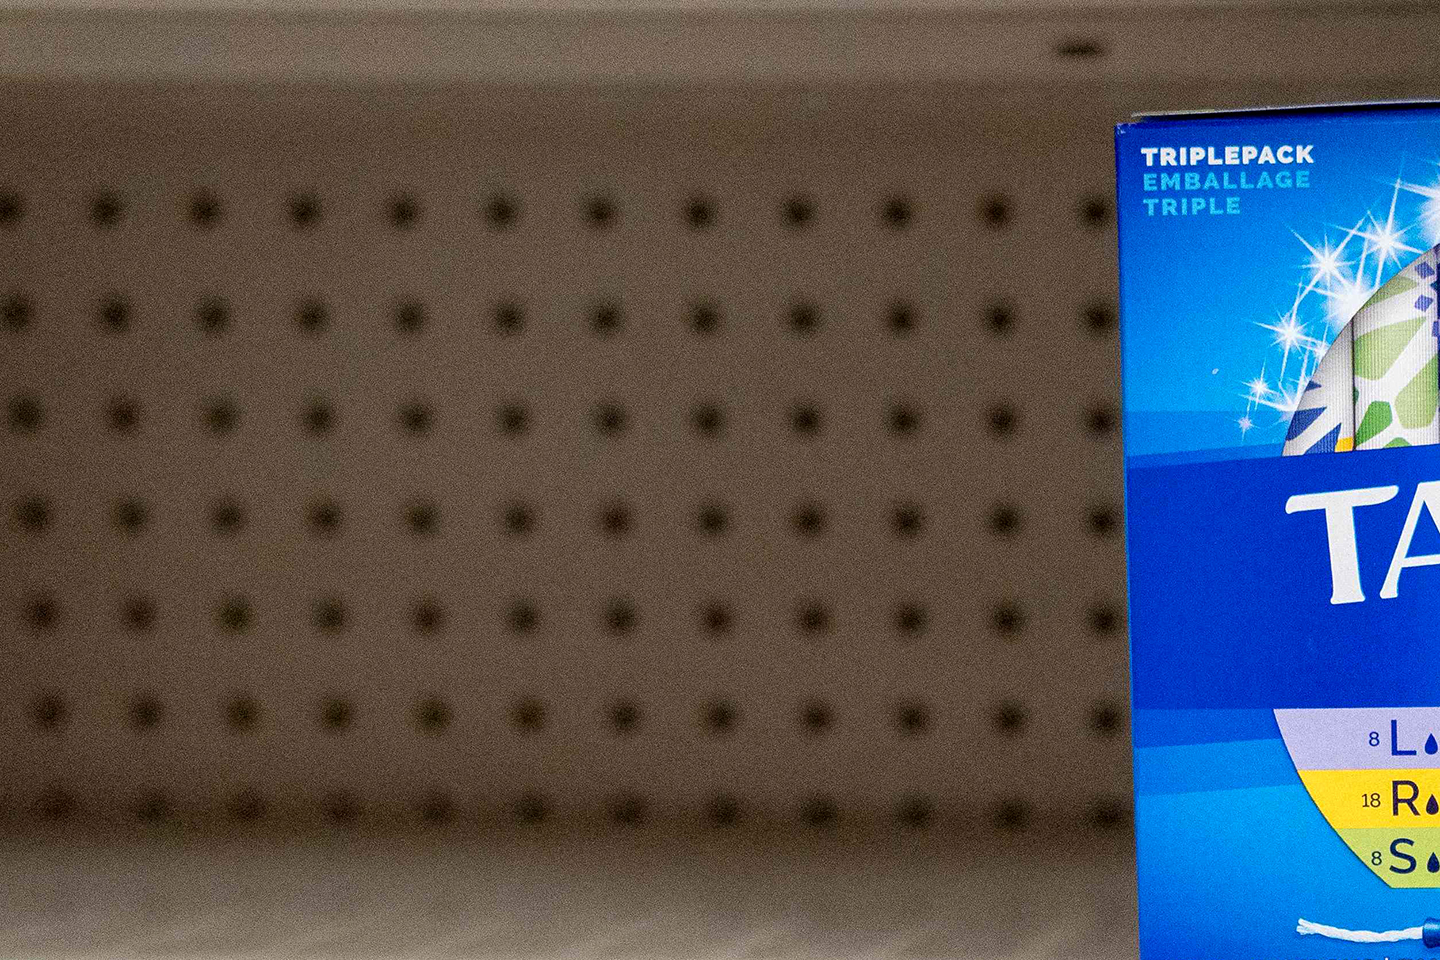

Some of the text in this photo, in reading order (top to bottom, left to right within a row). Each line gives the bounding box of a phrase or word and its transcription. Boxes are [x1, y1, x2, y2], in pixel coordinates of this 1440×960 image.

[1141, 144, 1314, 166] TRIPLEPACK
[1143, 170, 1310, 191] EMBALLAGE
[1144, 197, 1241, 216] TRIPLE
[1369, 719, 1417, 756] 8 L
[1361, 780, 1420, 816] 18 R
[1371, 838, 1417, 874] 8 S
